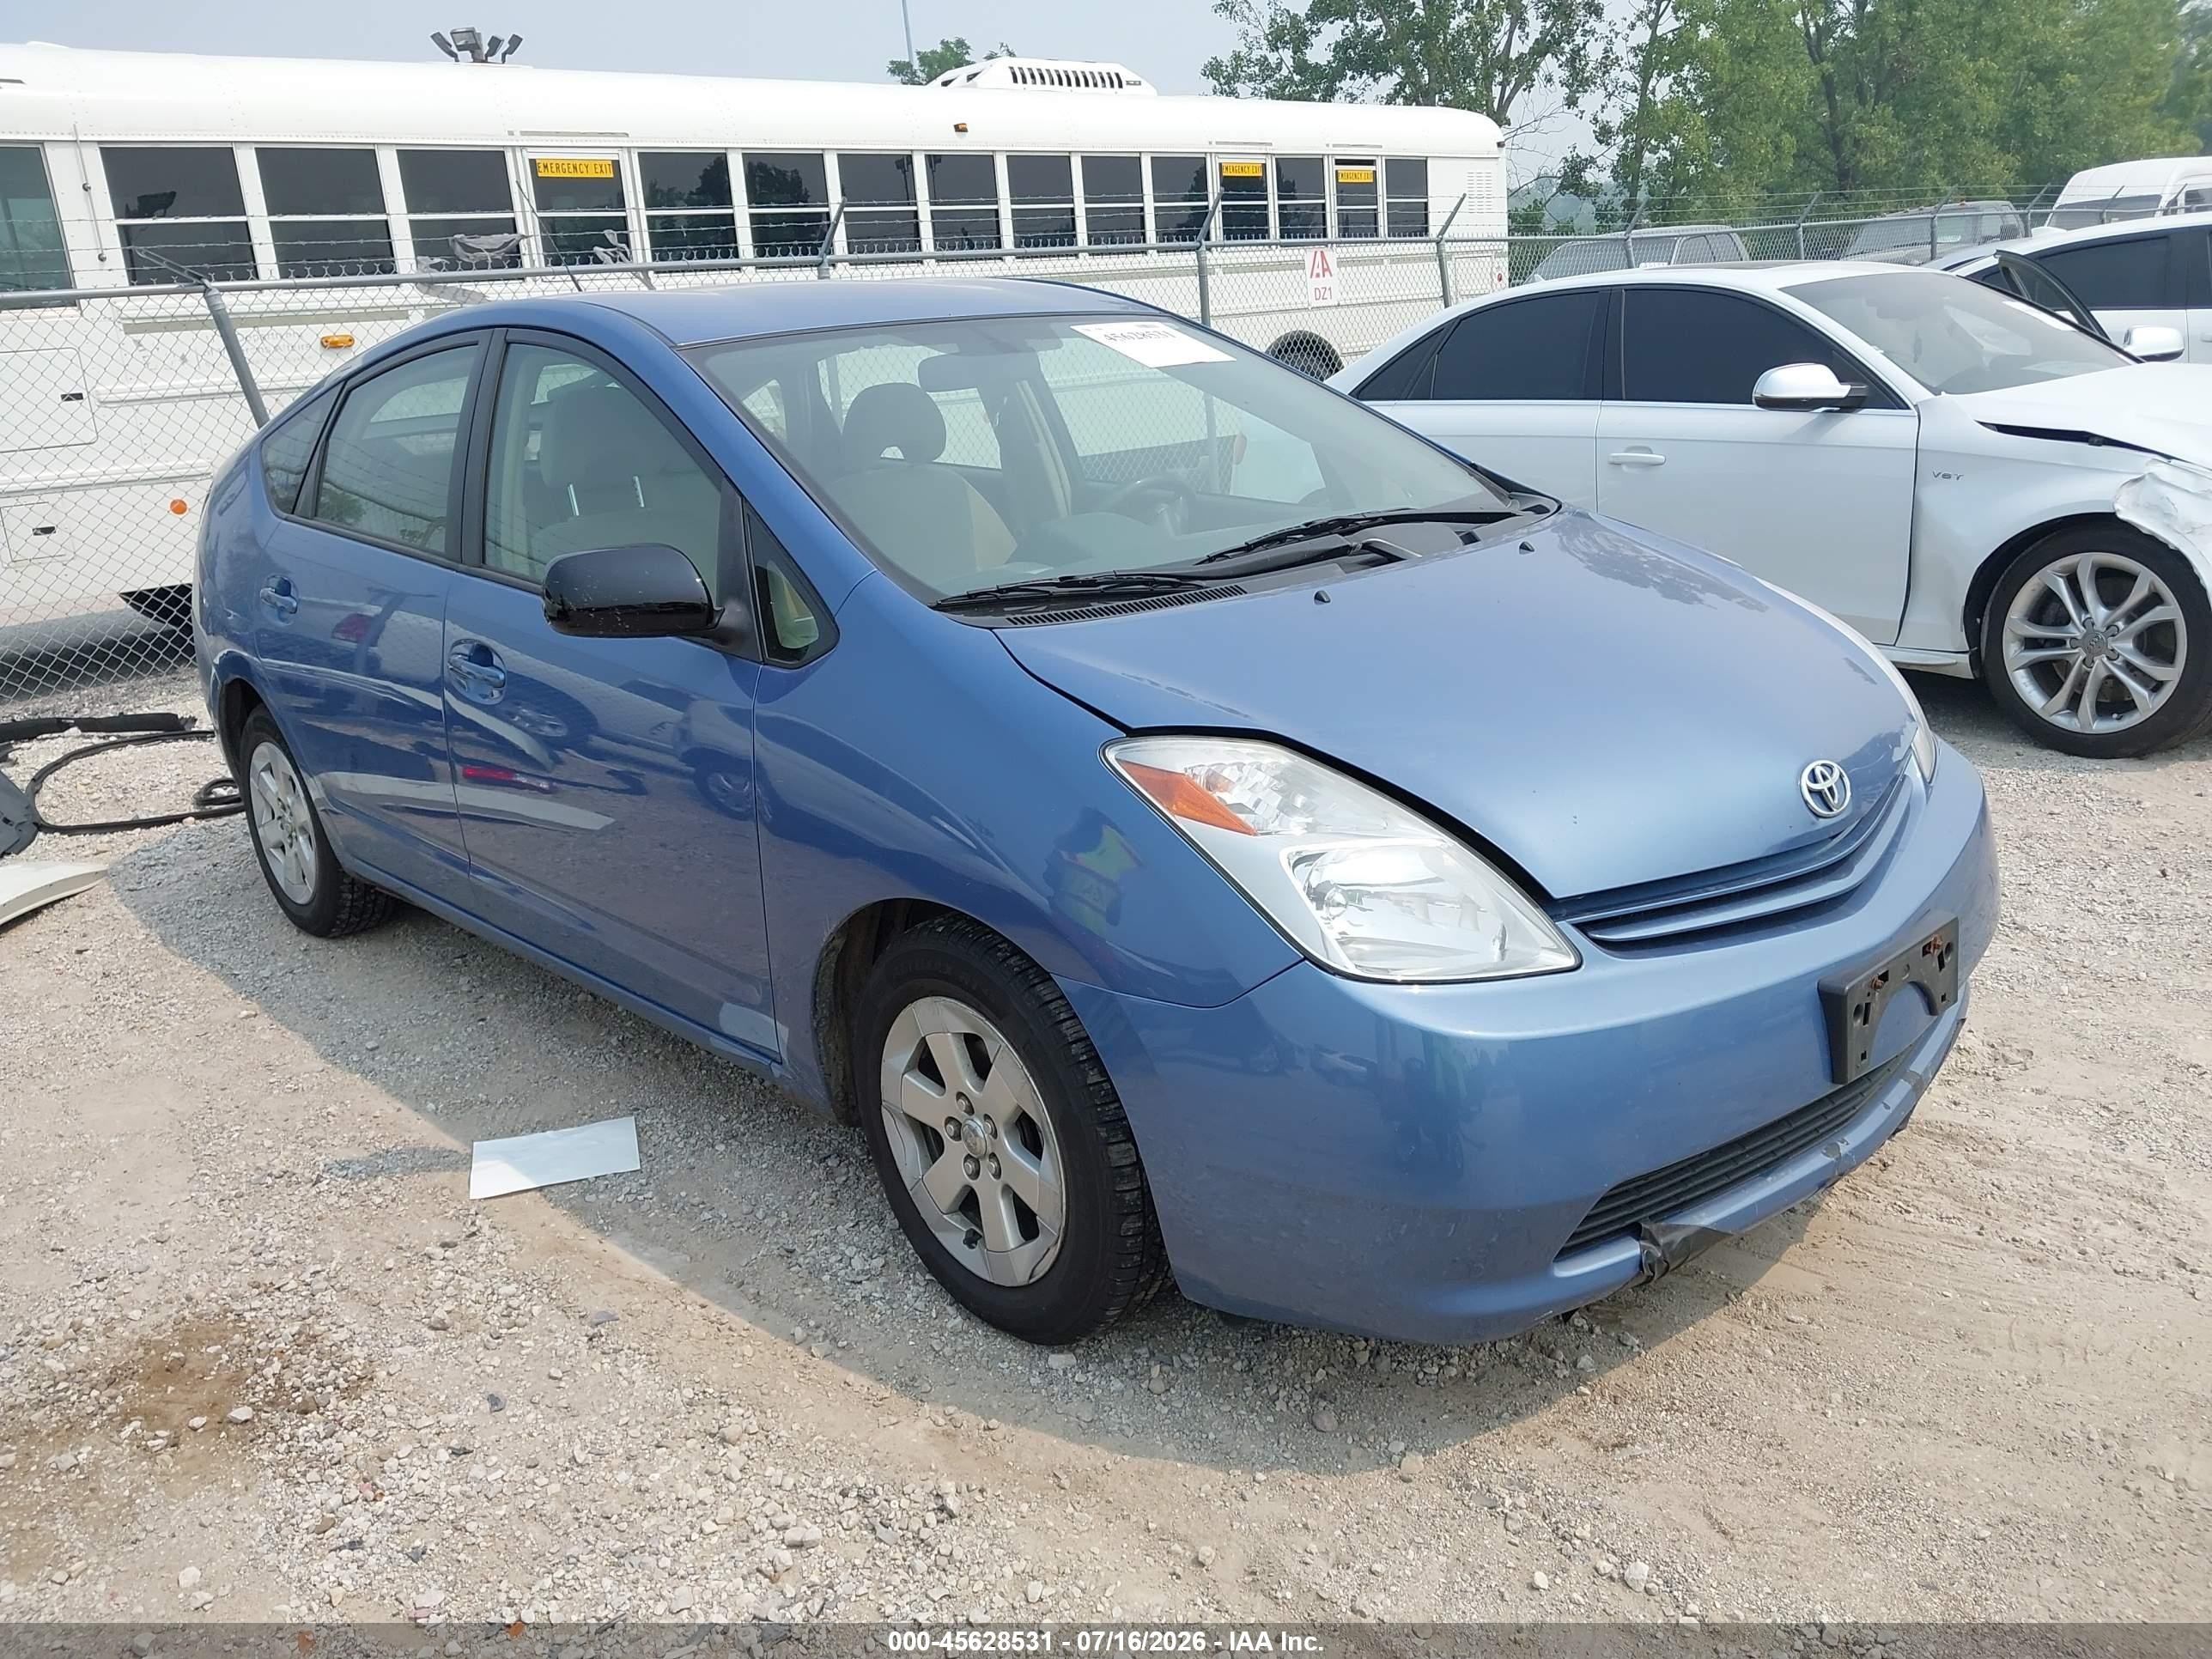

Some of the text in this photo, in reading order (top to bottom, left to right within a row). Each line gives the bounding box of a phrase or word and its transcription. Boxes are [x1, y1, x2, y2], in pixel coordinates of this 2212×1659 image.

[537, 161, 613, 174] EMERGENCY EXIT
[1222, 164, 1250, 174] EMERGENCY
[1314, 287, 1333, 301] DZ1
